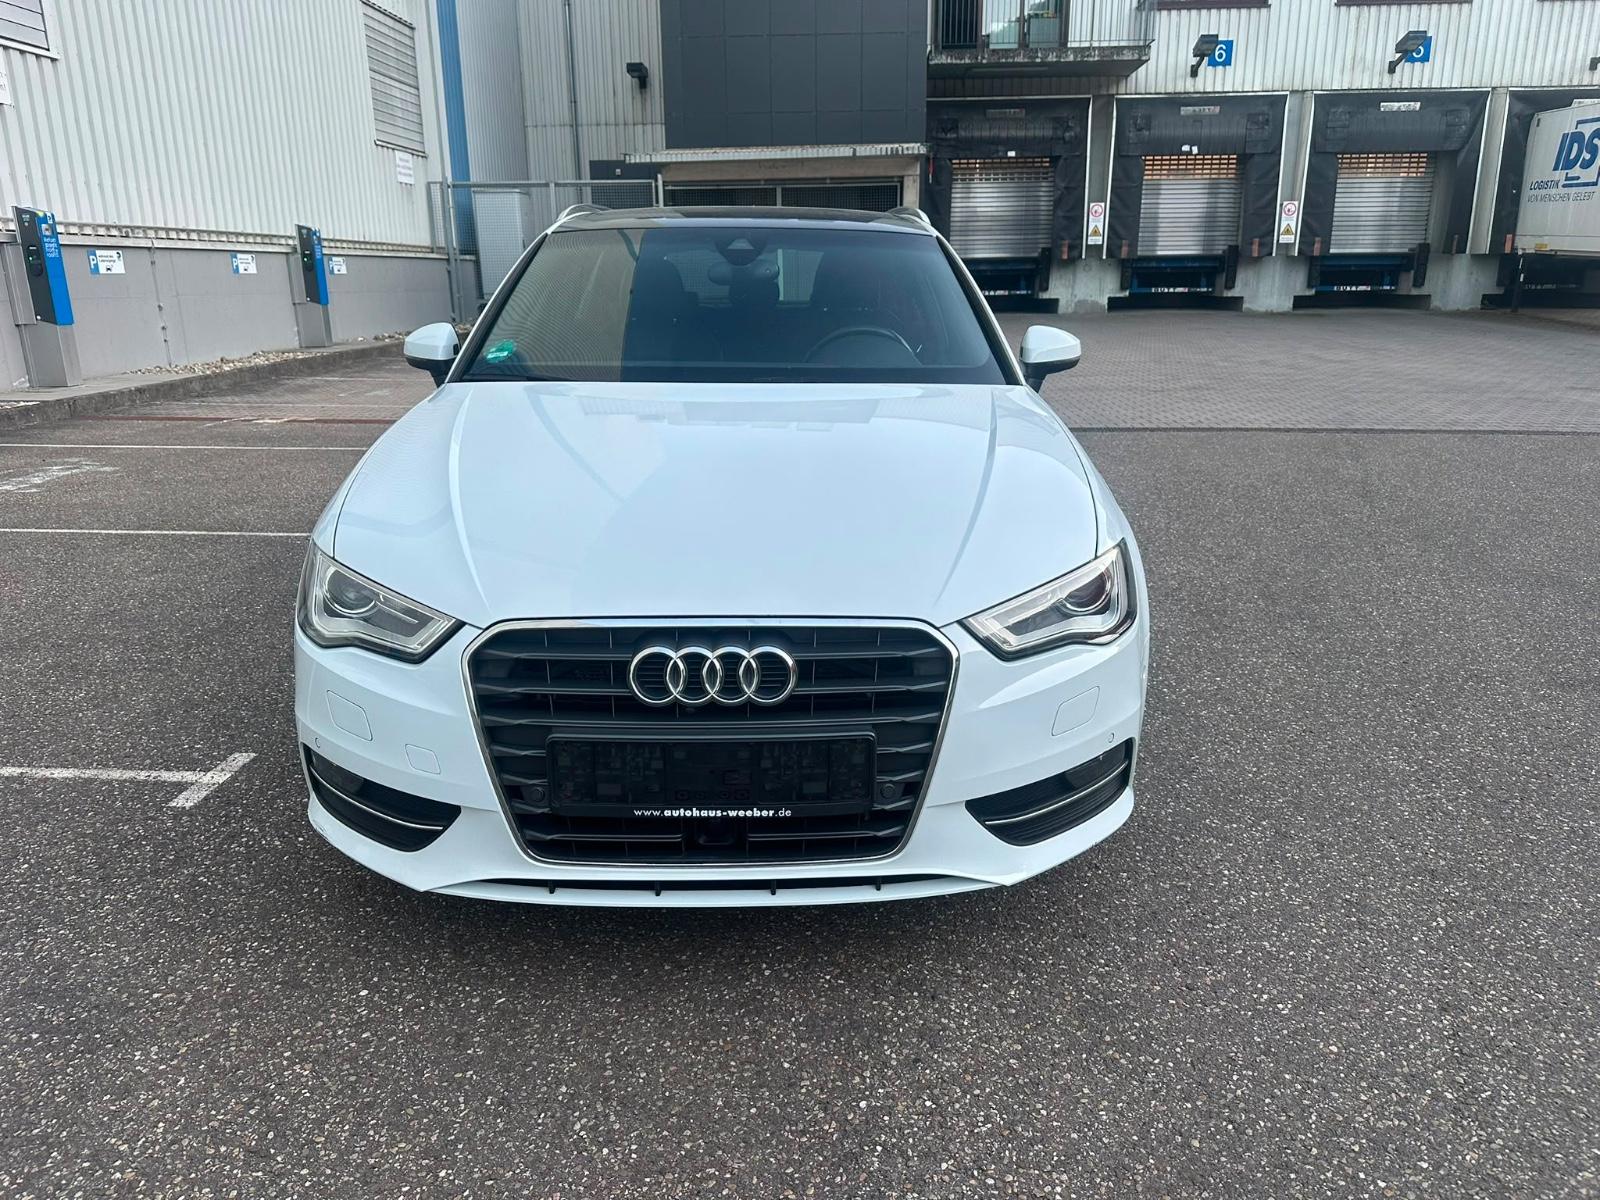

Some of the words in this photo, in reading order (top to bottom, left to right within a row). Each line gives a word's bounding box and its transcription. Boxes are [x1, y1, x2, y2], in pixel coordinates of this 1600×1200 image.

[1215, 44, 1226, 62] 6
[1552, 127, 1600, 171] IDS
[1529, 180, 1560, 190] LOGISTIK
[1528, 193, 1539, 203] VON
[1540, 192, 1570, 202] MENSCHEN
[1571, 191, 1595, 201] GELEBT
[89, 255, 98, 269] P
[232, 258, 238, 269] P
[633, 807, 792, 817] www.autohaus-weeber.de
